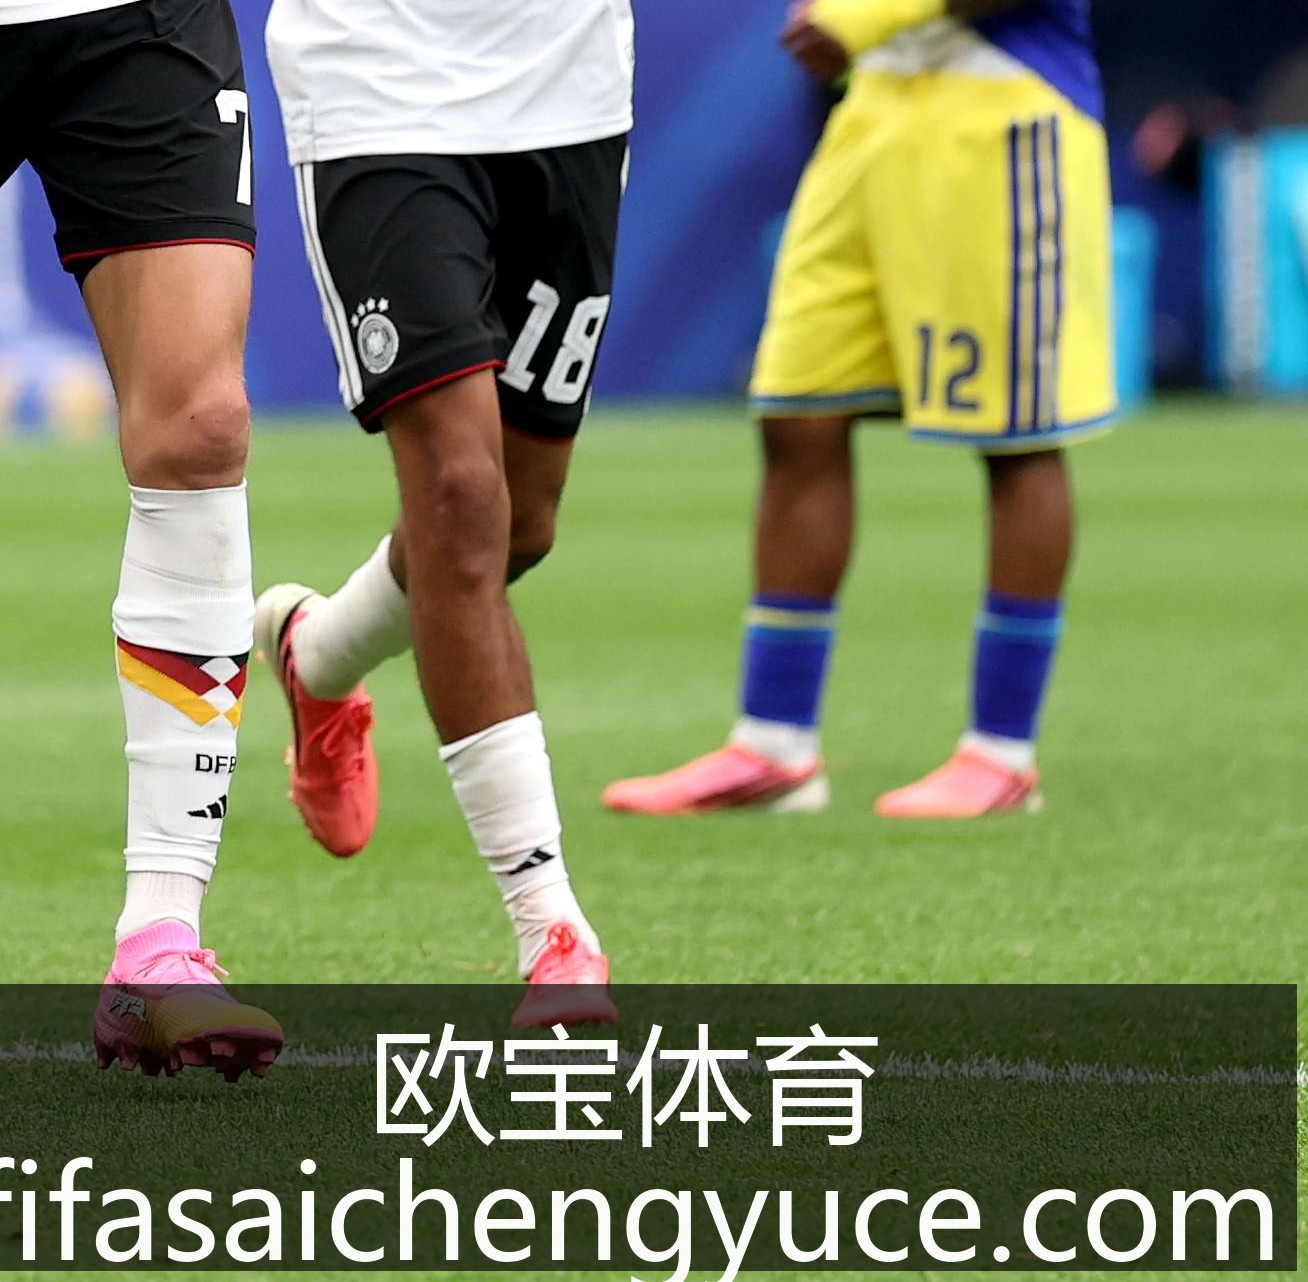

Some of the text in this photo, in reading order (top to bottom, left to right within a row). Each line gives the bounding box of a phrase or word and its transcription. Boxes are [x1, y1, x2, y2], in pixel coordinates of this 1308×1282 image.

[214, 89, 251, 206] 7
[497, 279, 610, 405] 18
[917, 322, 982, 413] 12
